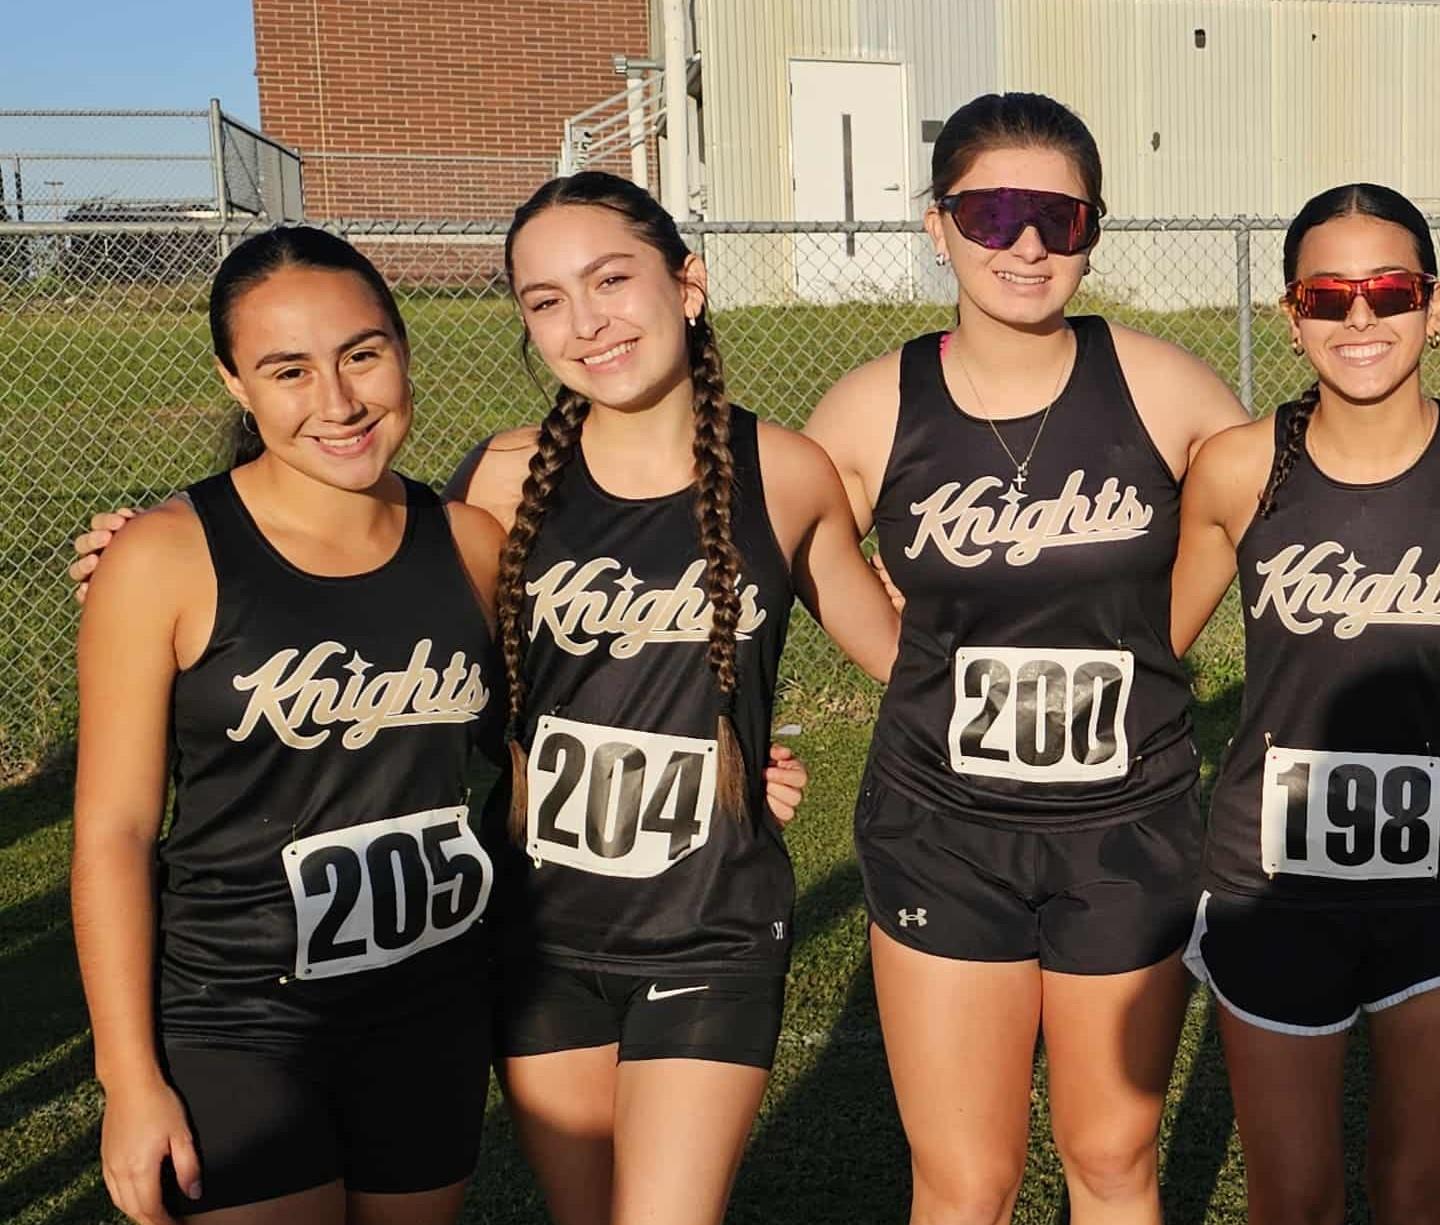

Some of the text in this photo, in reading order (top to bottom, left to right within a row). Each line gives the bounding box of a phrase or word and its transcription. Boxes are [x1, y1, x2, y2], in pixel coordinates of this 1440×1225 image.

[905, 469, 1153, 567] Knights
[526, 557, 767, 659] Knighs
[226, 638, 490, 750] Knights
[959, 658, 1124, 767] 200
[537, 732, 706, 860] 204
[1277, 762, 1432, 867] 198
[299, 820, 484, 965] 205
